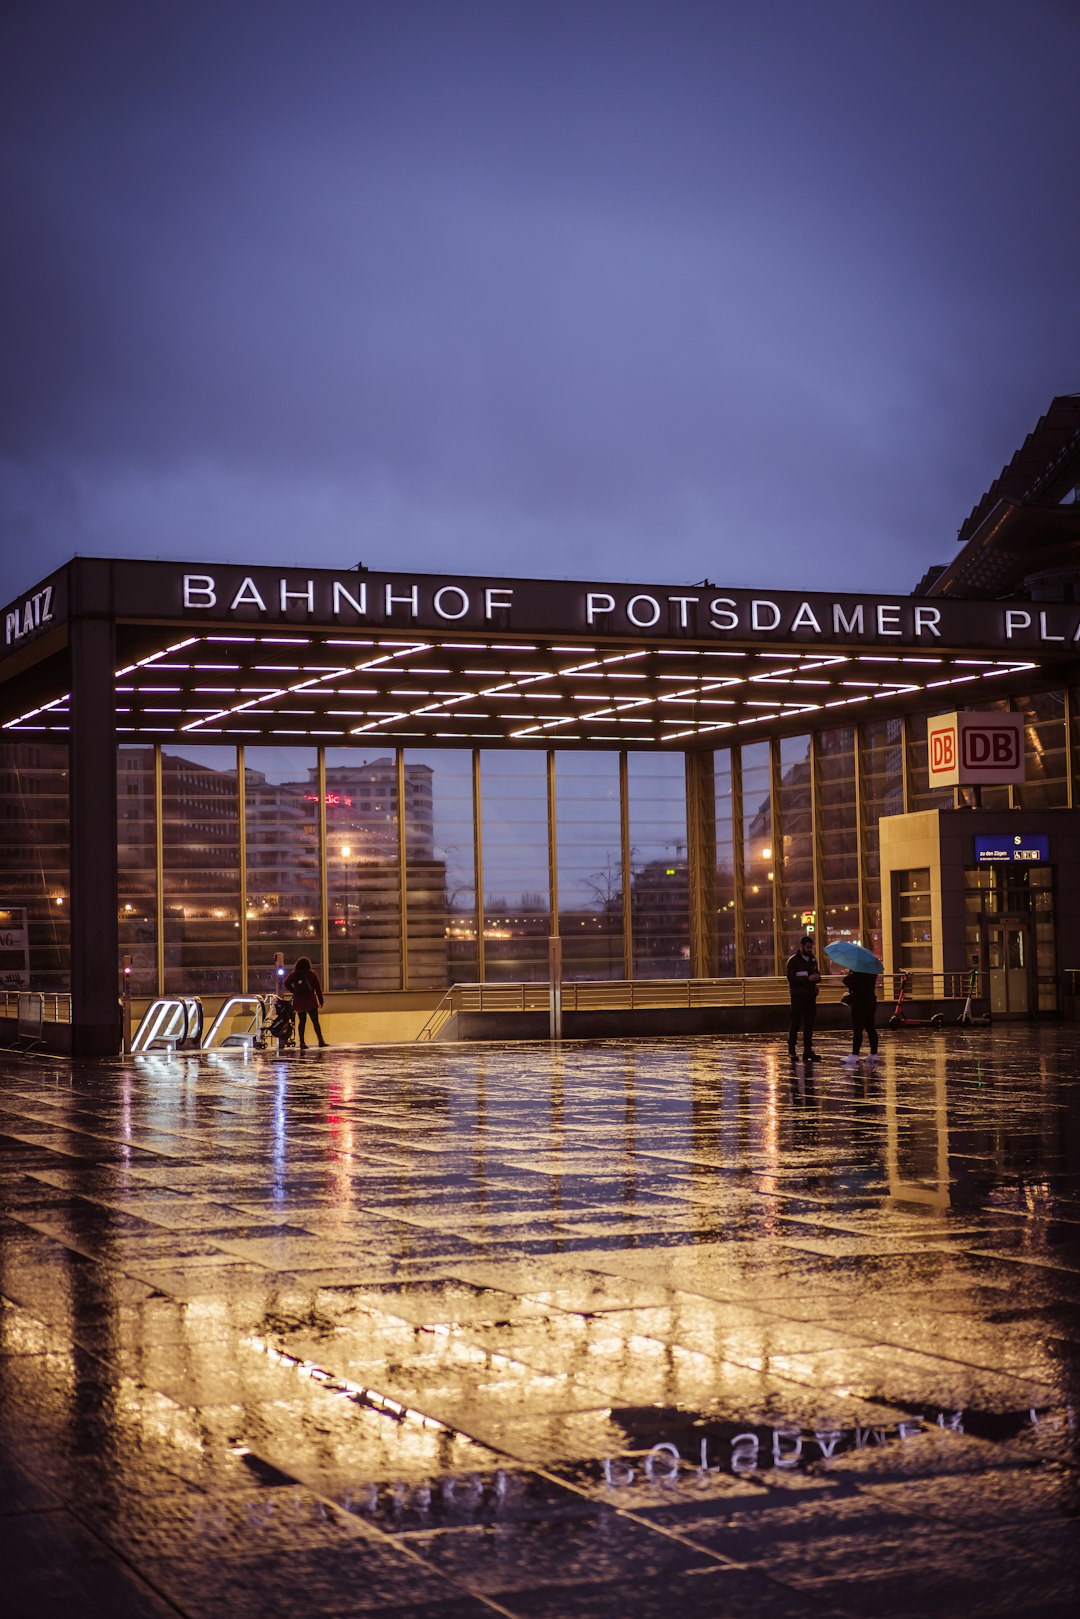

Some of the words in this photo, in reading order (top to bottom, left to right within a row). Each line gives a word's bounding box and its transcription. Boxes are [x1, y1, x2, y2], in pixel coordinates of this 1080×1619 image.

[5, 585, 53, 645] PLATZ
[183, 574, 514, 620] BAHNHOF
[586, 592, 942, 637] POTSDAMER
[934, 735, 953, 766] DB
[969, 733, 1013, 762] DB
[1014, 835, 1022, 845] S
